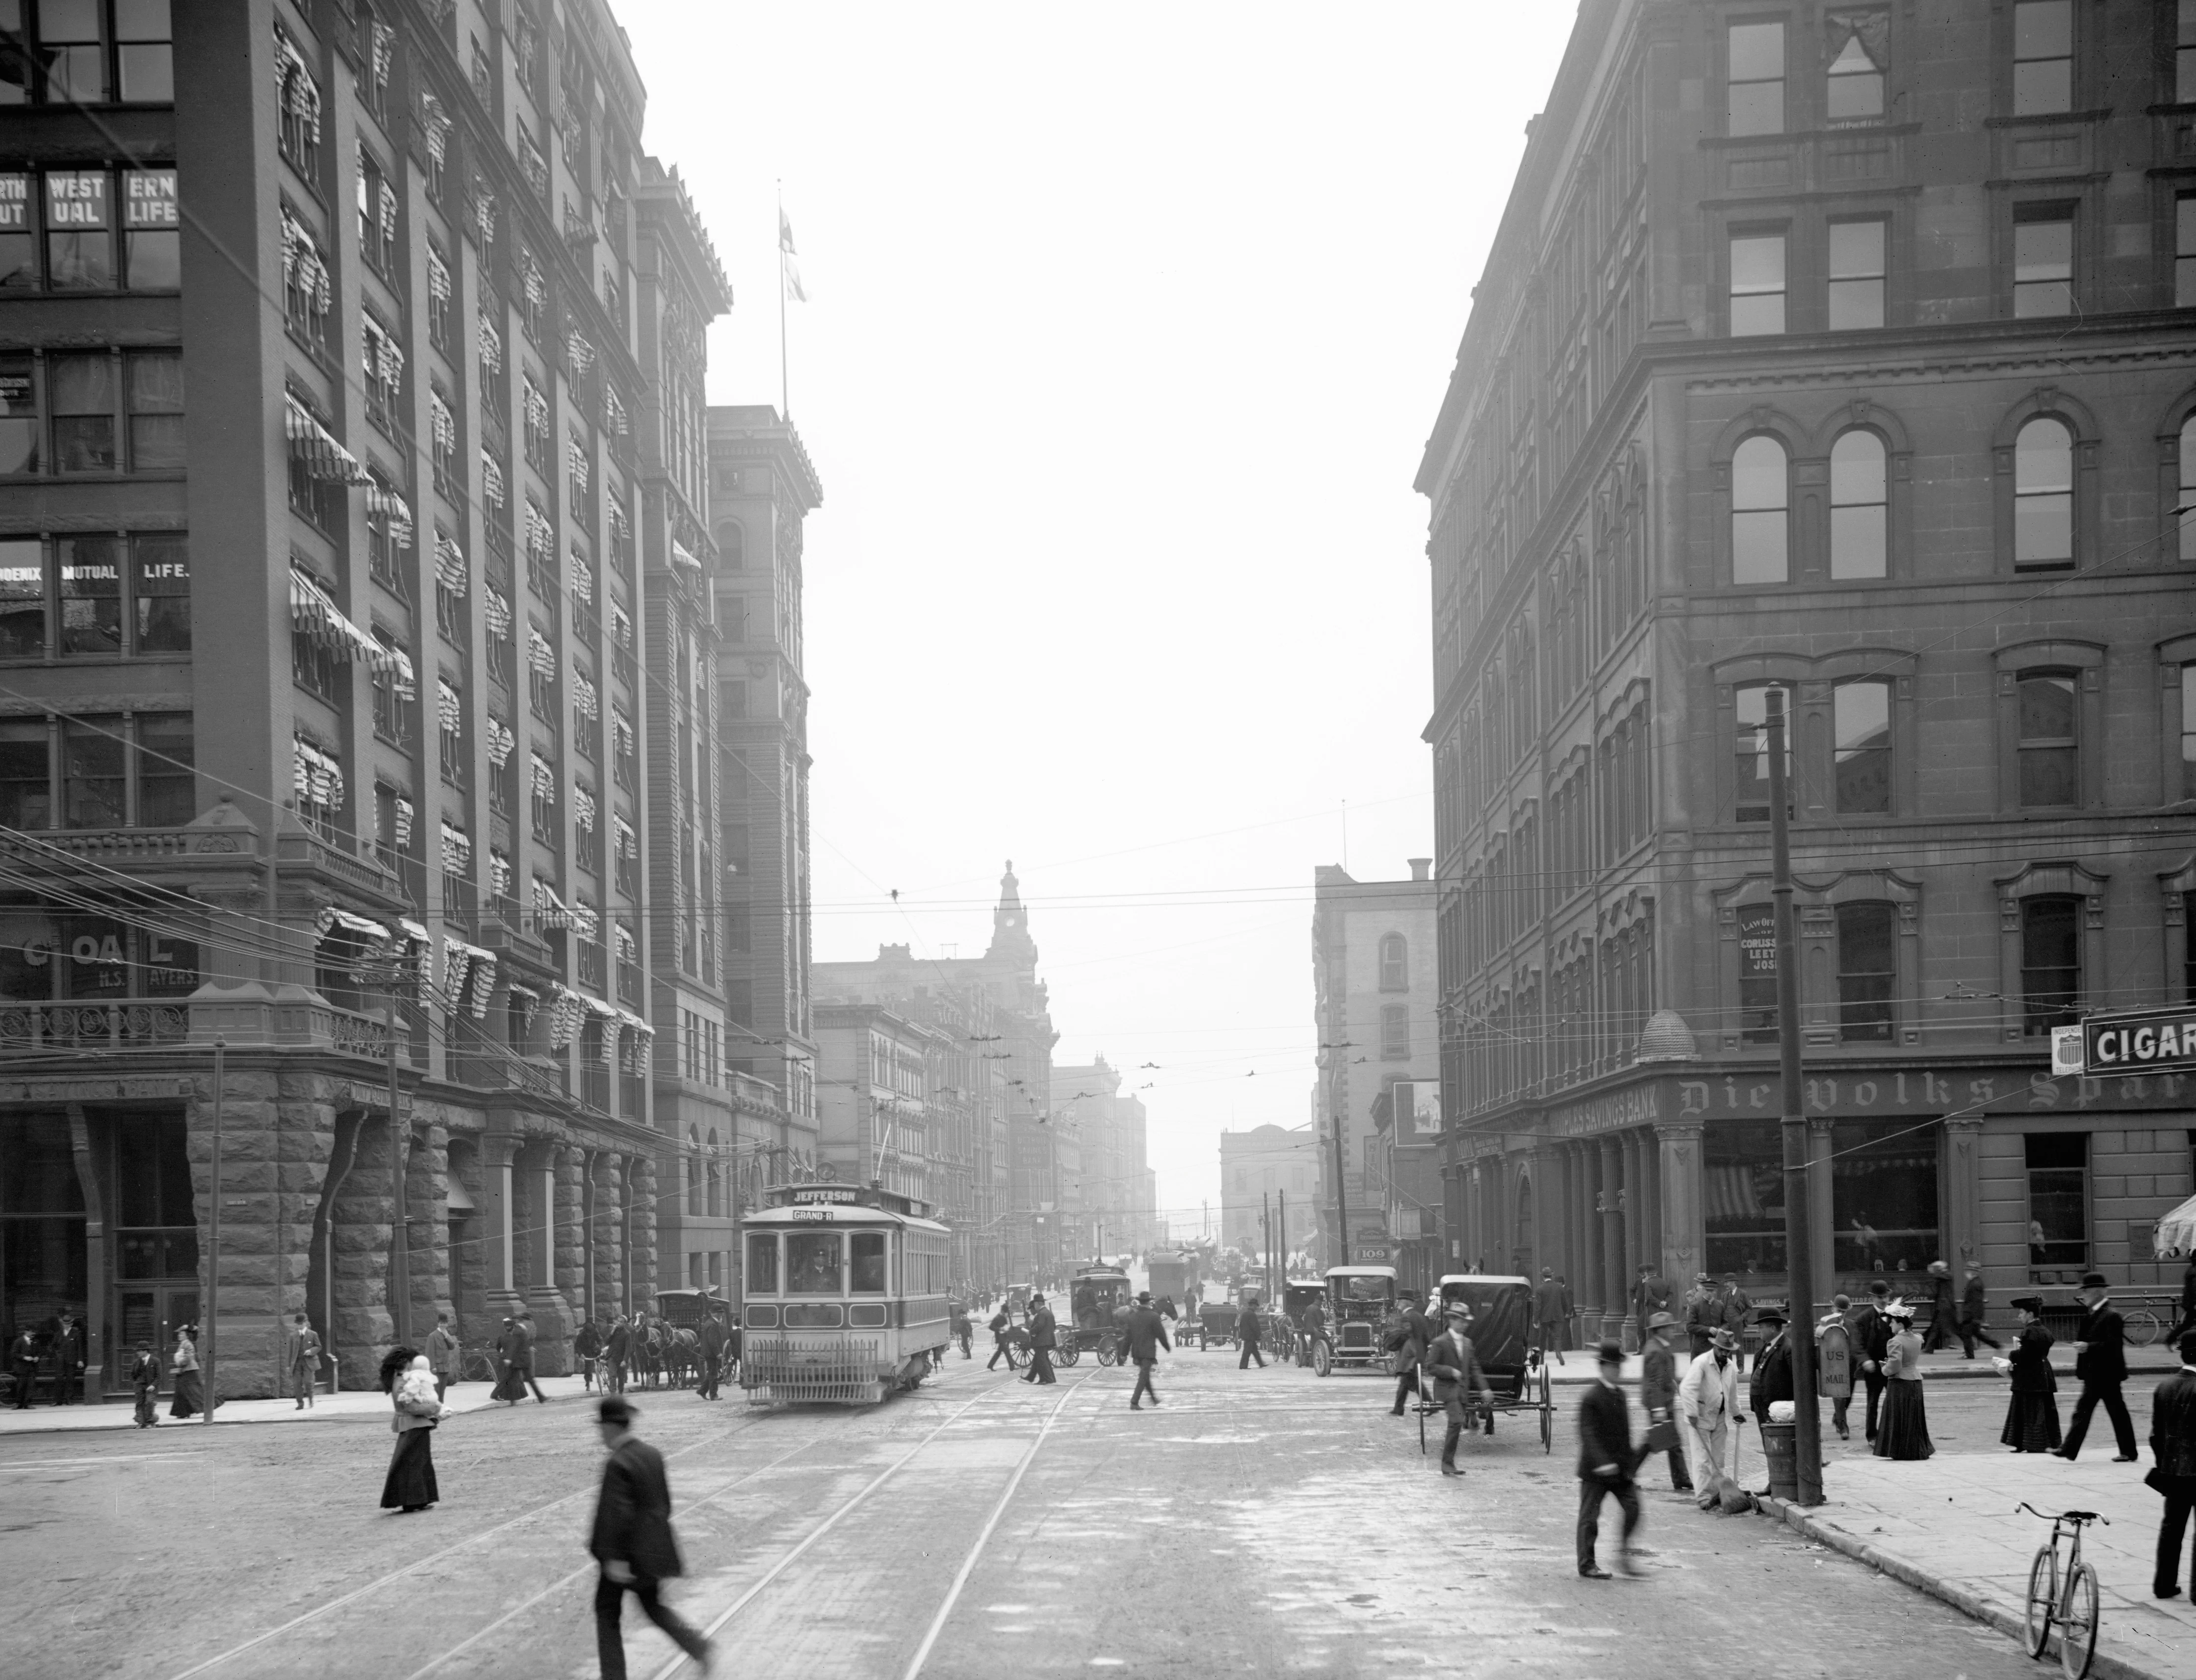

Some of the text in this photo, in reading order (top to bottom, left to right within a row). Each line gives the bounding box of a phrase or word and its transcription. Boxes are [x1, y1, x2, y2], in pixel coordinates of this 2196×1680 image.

[49, 178, 104, 198] WEST
[129, 176, 174, 197] ERN
[54, 202, 99, 222] UAL
[61, 565, 118, 580] MUTUAL
[144, 563, 190, 578] LIFE.
[1742, 920, 1761, 932] LAW
[1678, 1075, 1771, 1118] Die
[1585, 1093, 1625, 1132] SAVINGS
[1627, 1084, 1657, 1123] BANK
[794, 1191, 856, 1202] JEFFERSON
[1362, 1249, 1385, 1258] 109
[1825, 1351, 1844, 1361] US
[1825, 1374, 1846, 1384] MAIL
